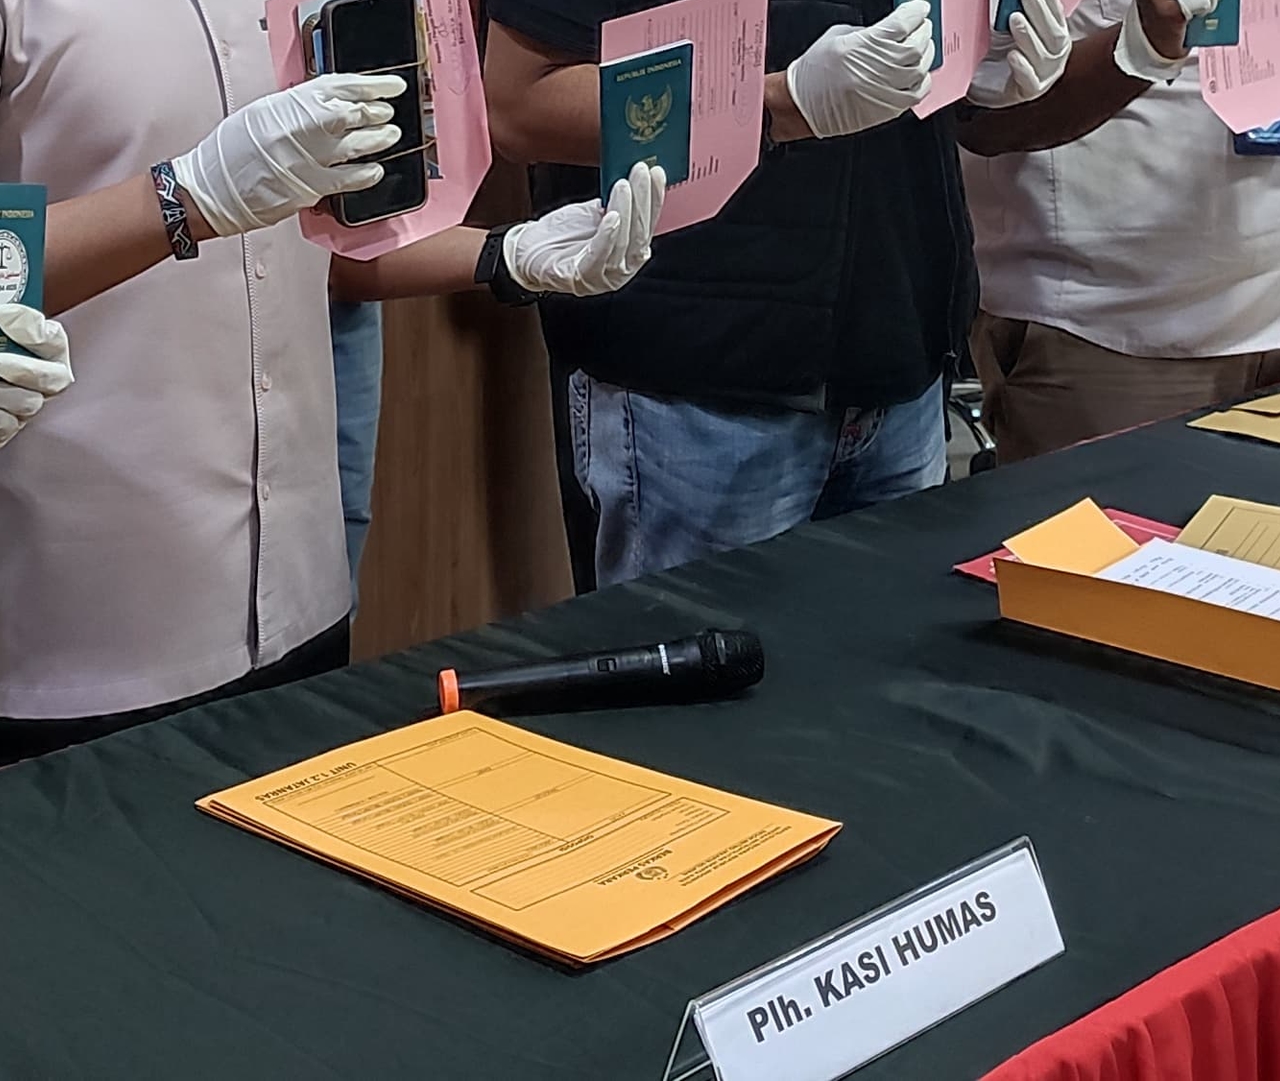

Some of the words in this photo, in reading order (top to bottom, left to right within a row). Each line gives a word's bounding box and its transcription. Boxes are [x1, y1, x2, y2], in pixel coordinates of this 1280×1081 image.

[329, 761, 358, 776] UNIT
[254, 777, 311, 801] JATANRAS
[746, 995, 812, 1044] Plh.
[813, 944, 891, 1008] KASI
[891, 890, 998, 966] HUMAS
